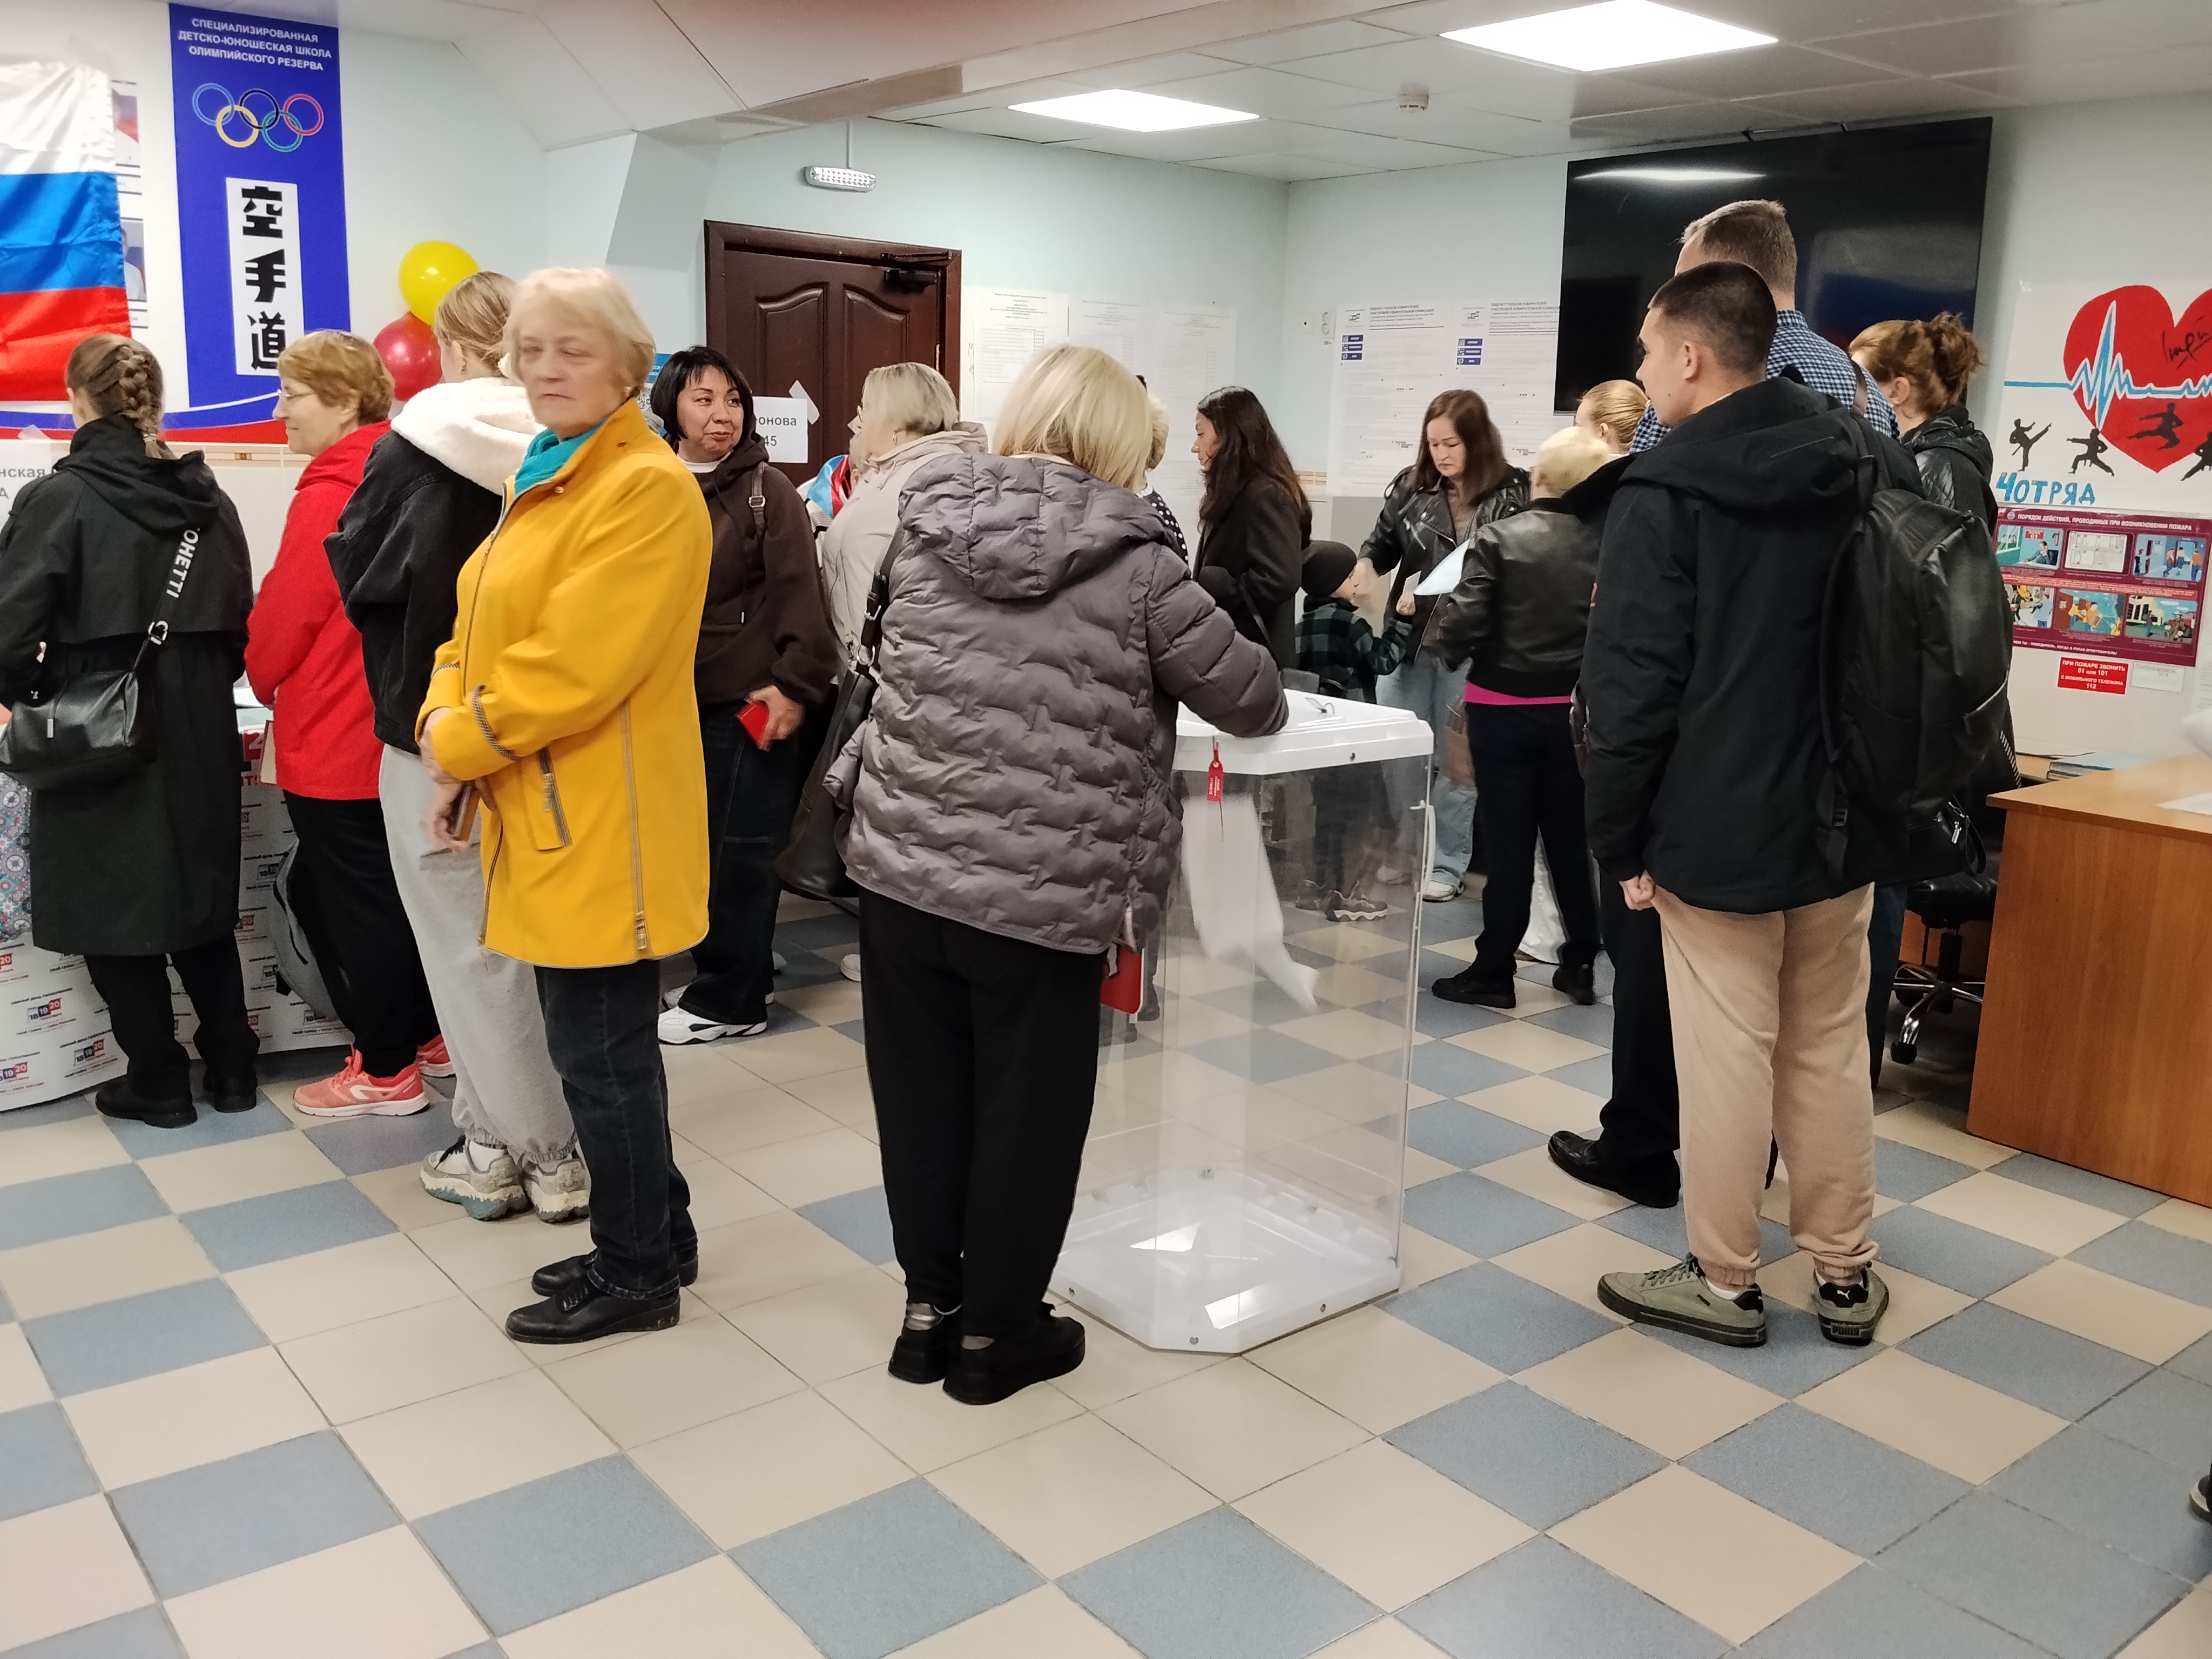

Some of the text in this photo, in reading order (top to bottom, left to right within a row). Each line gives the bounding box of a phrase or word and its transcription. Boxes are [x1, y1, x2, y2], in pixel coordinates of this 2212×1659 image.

[192, 18, 318, 43] СПЕЦИАЛИЗИРОВАННАЯ
[178, 30, 332, 58] ДЕТСКО-ЮНОШЕСКАЯ ШКОЛА
[189, 45, 323, 71] ОЛИМПИЙСКОГО РЕЗЕРВА
[241, 185, 287, 370] 空手道
[2042, 515, 2071, 523] ДЕЙСТВИЙ,
[2072, 517, 2108, 526] ПРОВОДИМЫХ
[2121, 521, 2168, 529] ВОЗНИКНОВЕНИИ
[2065, 675, 2098, 683] МОБИЛЬНОГО
[49, 1001, 60, 1009] 20
[15, 1064, 27, 1073] 20
